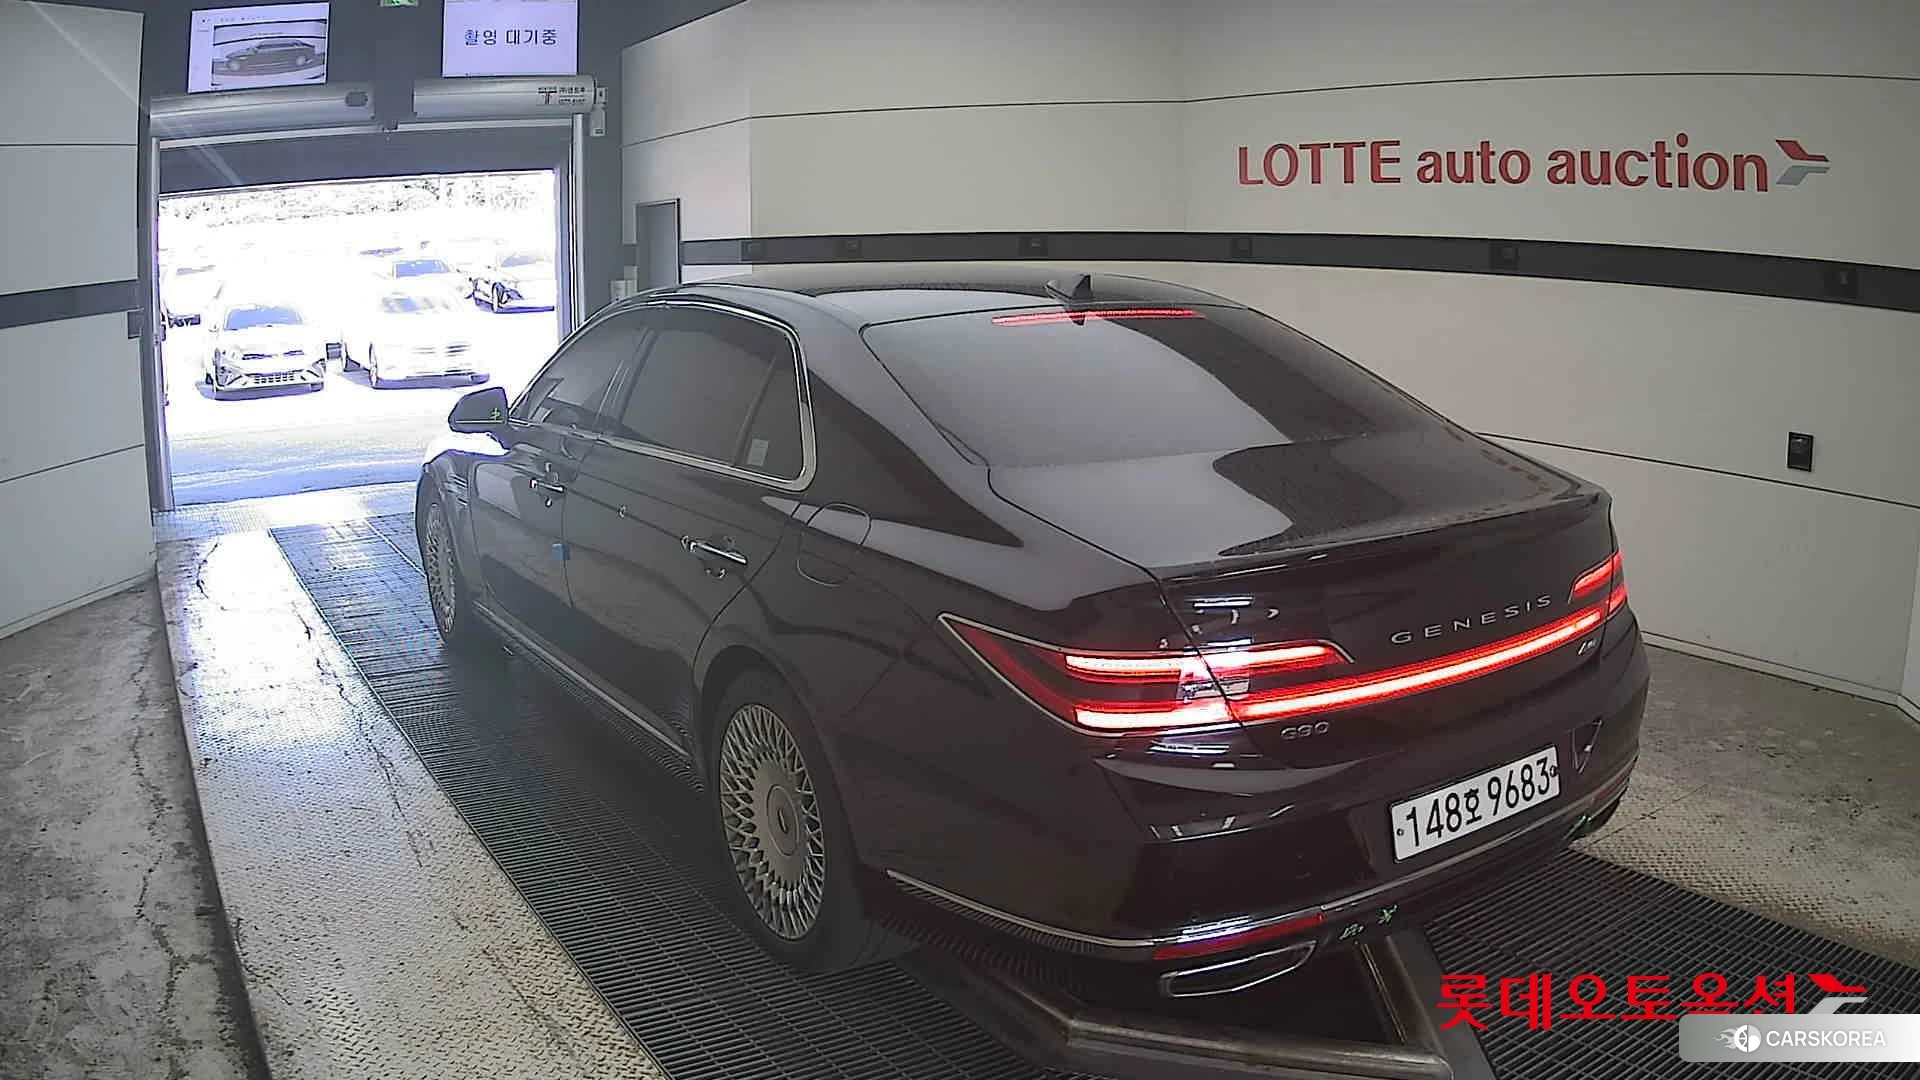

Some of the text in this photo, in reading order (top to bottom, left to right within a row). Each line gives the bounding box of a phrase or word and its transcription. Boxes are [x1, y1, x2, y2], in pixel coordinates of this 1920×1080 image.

[506, 28, 557, 46] 대기중
[1238, 132, 1769, 192] LOTTE auto auction
[1391, 594, 1552, 644] GENESIS
[1280, 721, 1329, 740] G90
